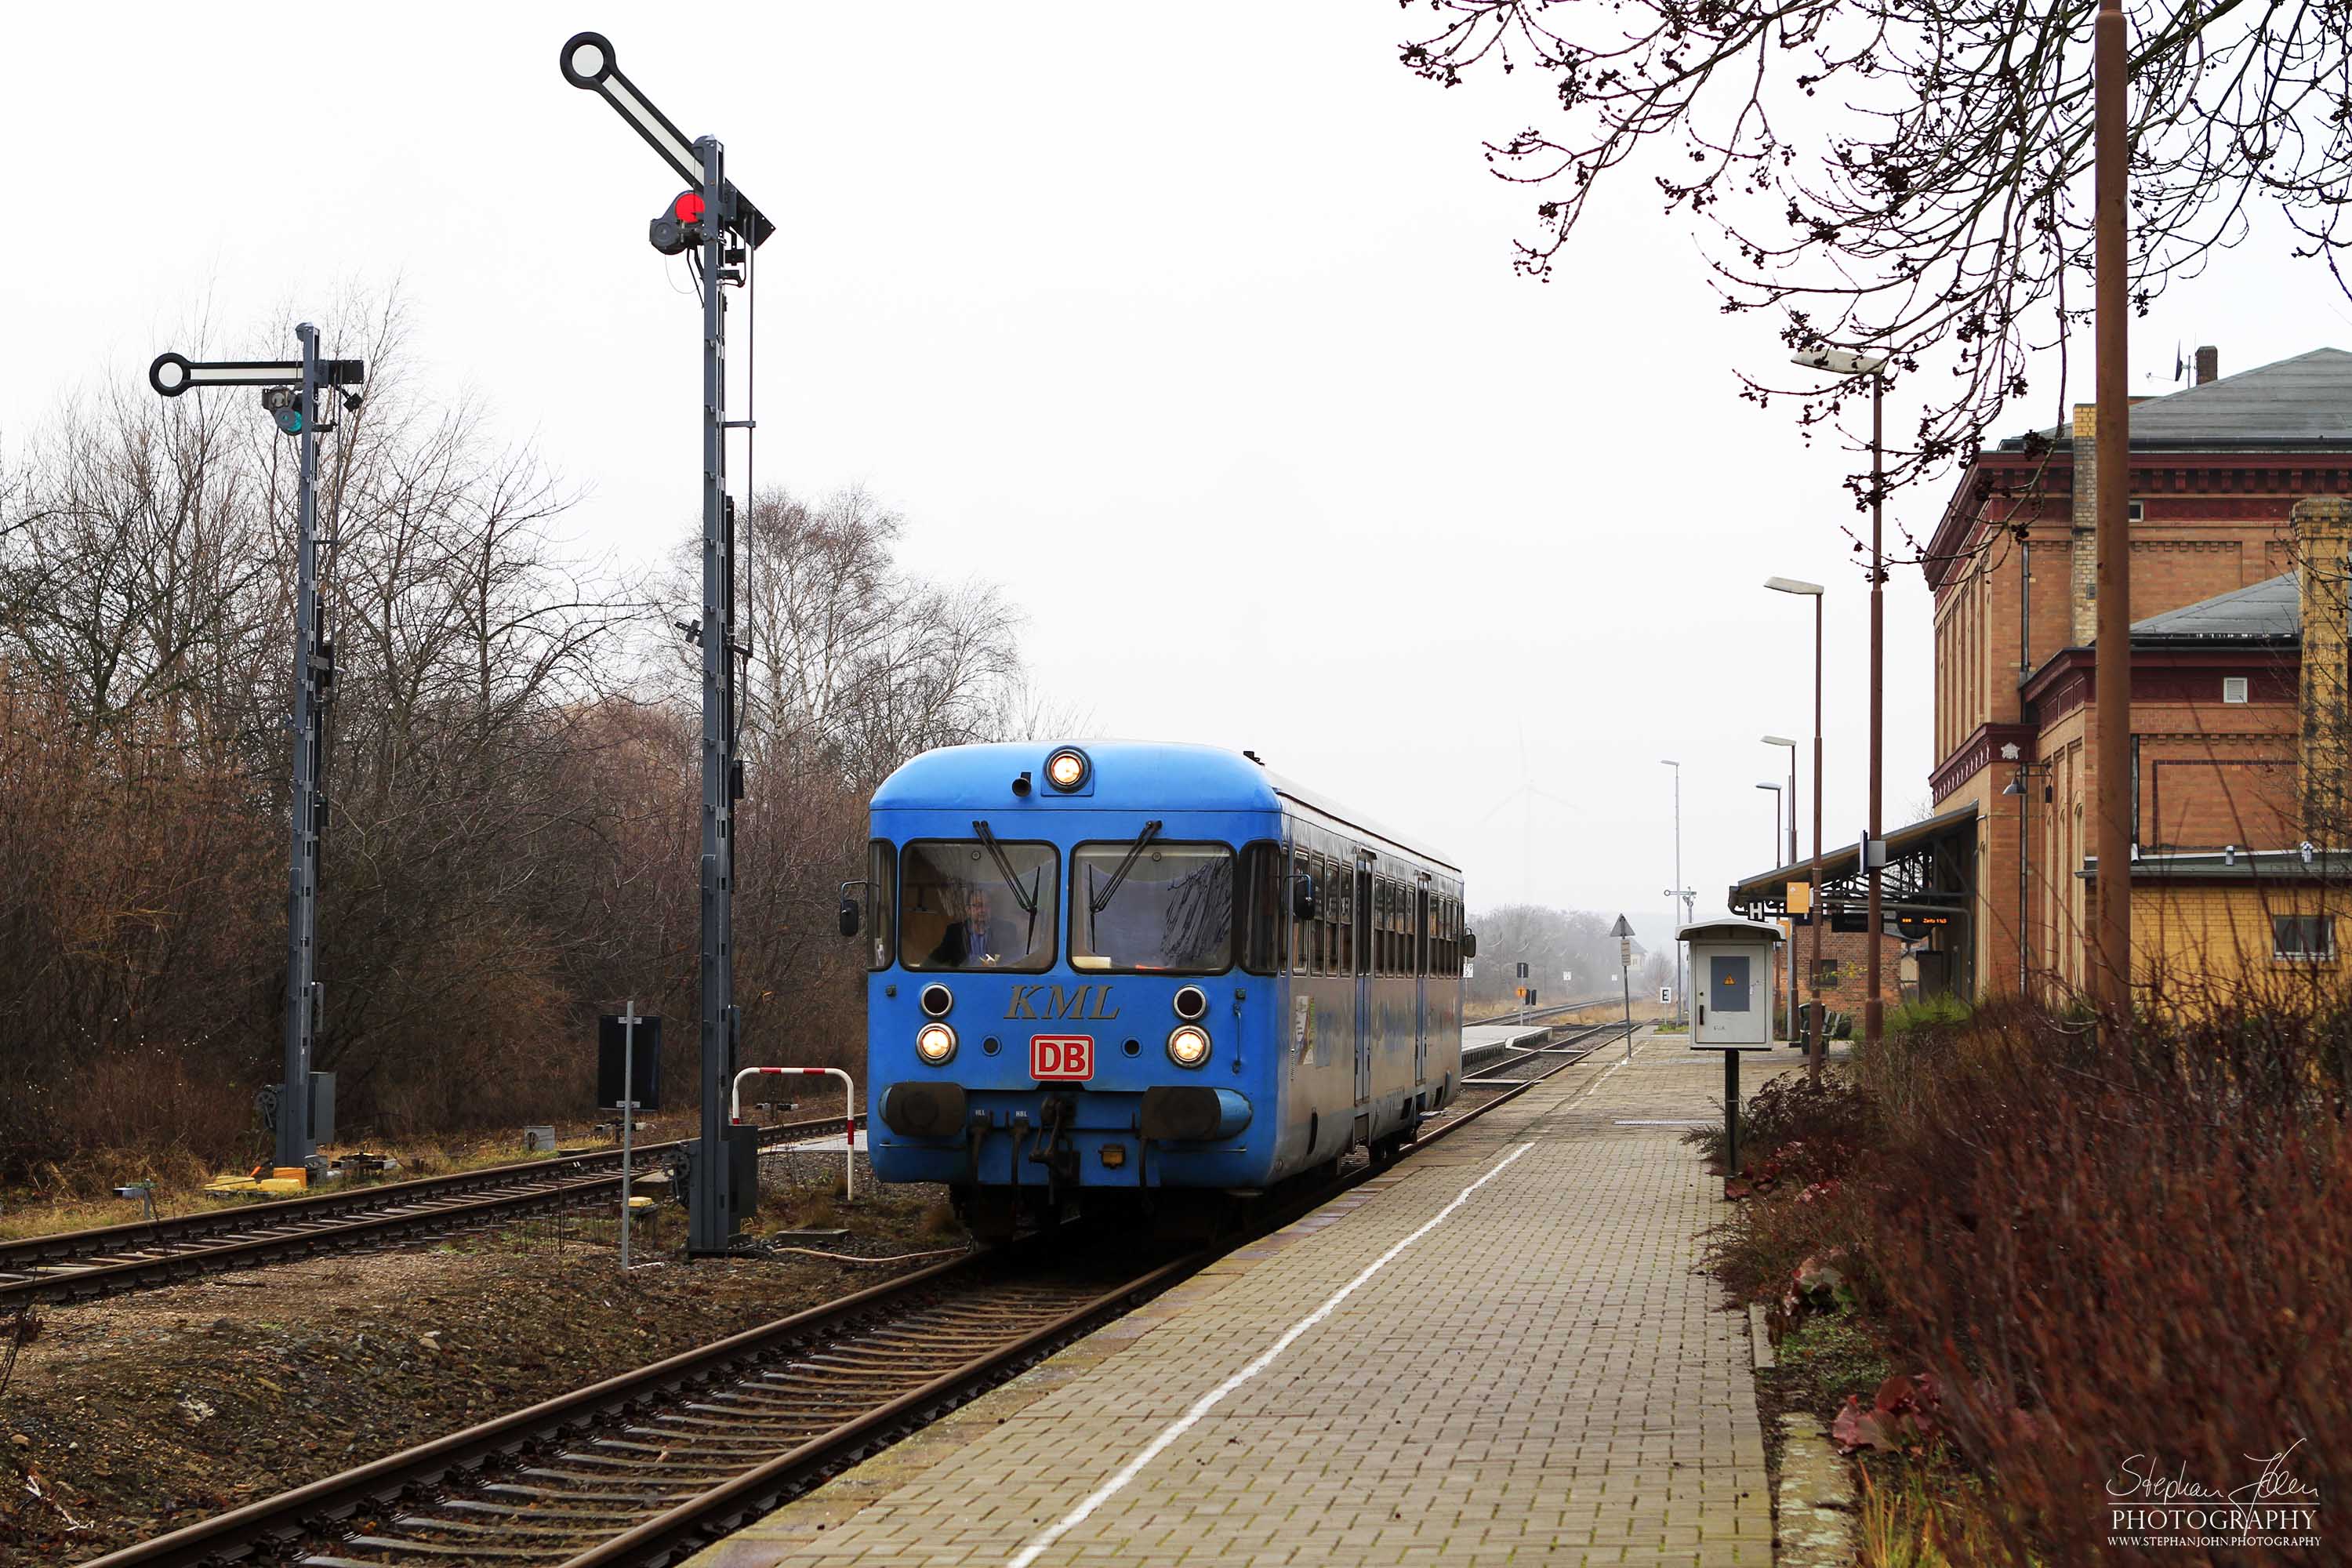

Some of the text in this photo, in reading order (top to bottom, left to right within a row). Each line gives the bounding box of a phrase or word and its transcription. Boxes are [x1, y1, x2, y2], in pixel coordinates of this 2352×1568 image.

[1749, 902, 1763, 920] H
[1003, 984, 1121, 1020] KML
[1662, 989, 1669, 1001] E
[1038, 1042, 1086, 1073] DB
